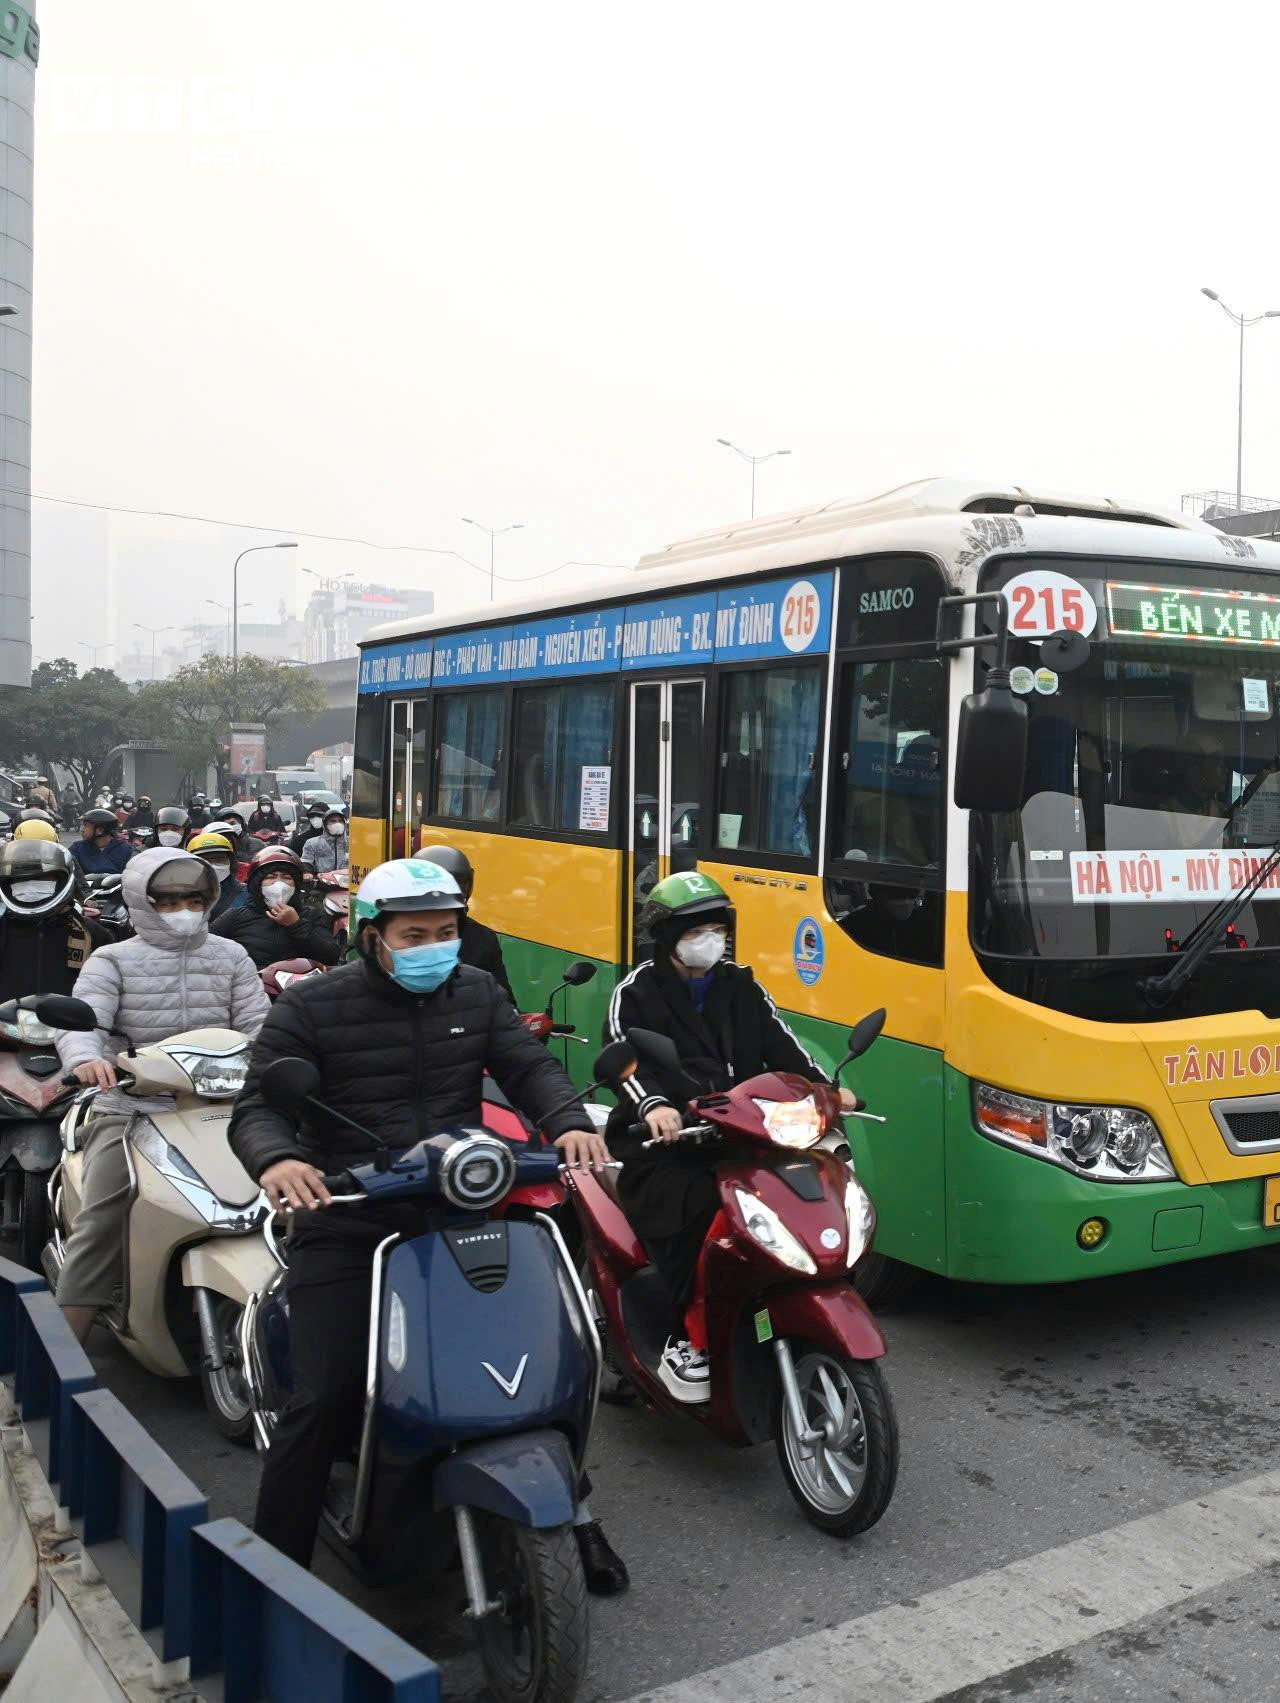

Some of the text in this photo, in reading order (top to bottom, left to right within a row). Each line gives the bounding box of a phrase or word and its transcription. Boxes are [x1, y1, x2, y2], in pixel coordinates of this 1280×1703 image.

[783, 594, 816, 637] 215
[859, 587, 915, 614] SAMCO
[1012, 585, 1086, 632] 215
[1139, 595, 1204, 635] BẾN
[1215, 608, 1251, 638] XE
[456, 639, 476, 675] PHÁP
[477, 637, 493, 673] VÂN
[498, 639, 518, 671] LINH
[518, 631, 538, 669] ĐÀM
[544, 618, 581, 666] NGUYỄN
[581, 613, 607, 662] XIỂN
[613, 619, 648, 665] PHẠM
[649, 610, 682, 655] HÙNG
[691, 611, 712, 651] BX.
[715, 600, 737, 648] MỸ
[738, 597, 775, 646] ĐÌNH
[1076, 853, 1113, 895] HÀ
[1118, 851, 1164, 900] NỘI
[1185, 851, 1223, 891] MỸ
[1163, 1044, 1226, 1086] TÂN
[456, 1233, 502, 1245] VINFAST
